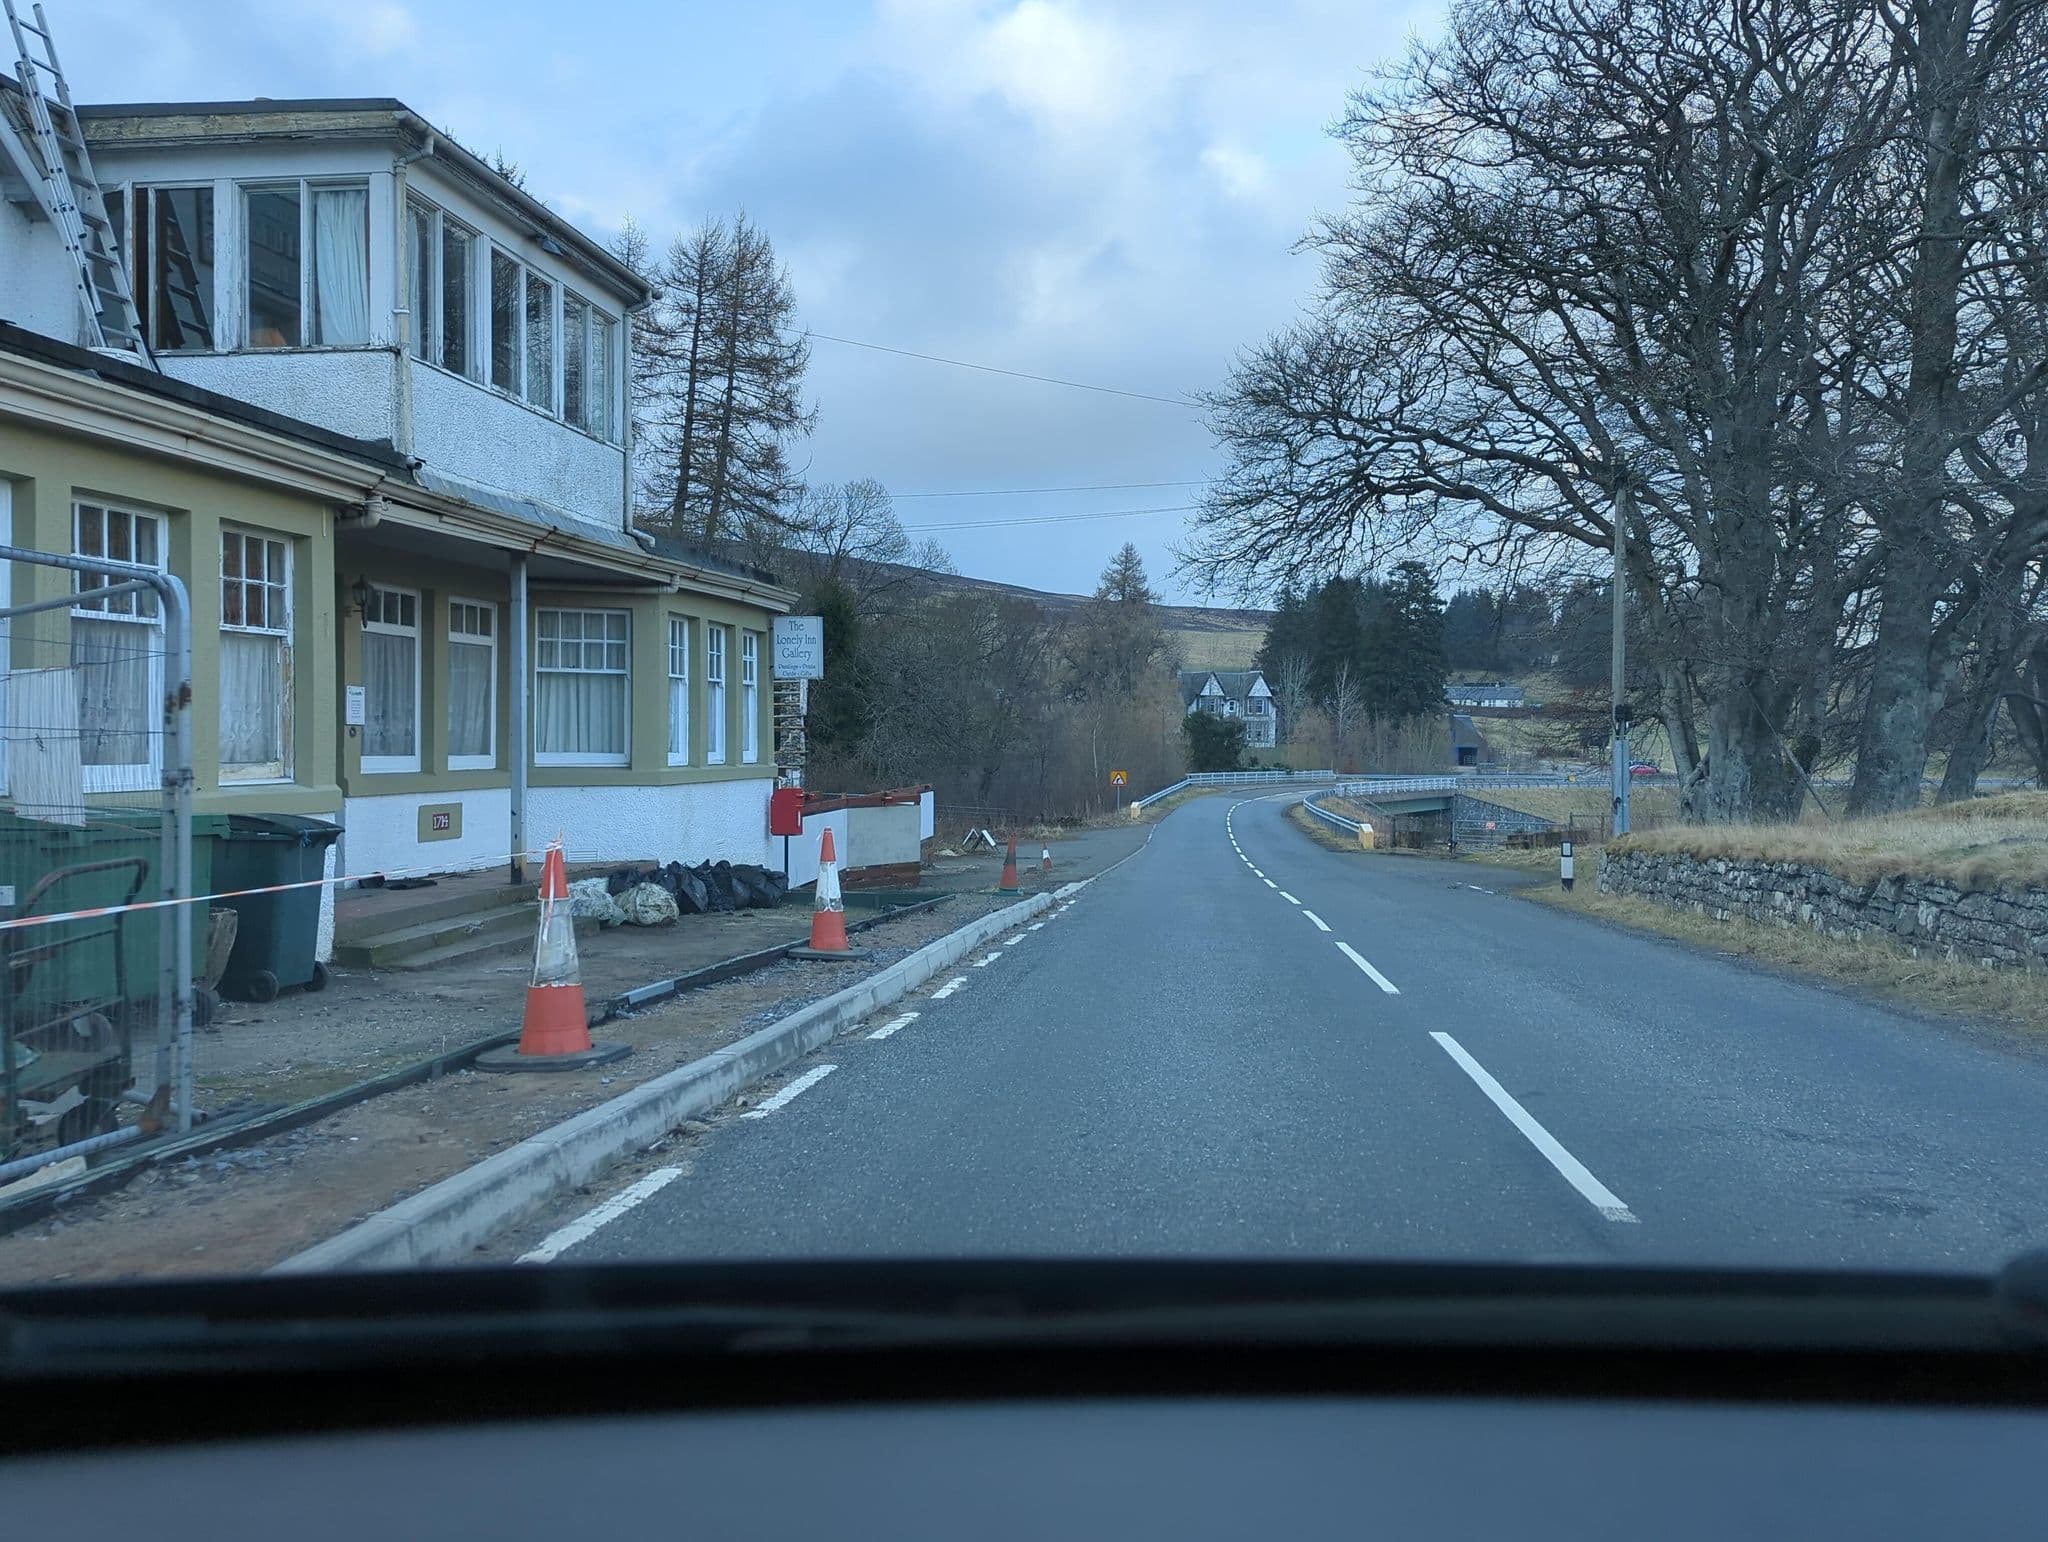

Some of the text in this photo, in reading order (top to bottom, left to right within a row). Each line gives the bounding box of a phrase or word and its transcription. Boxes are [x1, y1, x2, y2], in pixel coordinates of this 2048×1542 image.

[789, 620, 805, 631] The
[776, 634, 817, 649] Lonely Inn
[782, 647, 813, 661] Gallery
